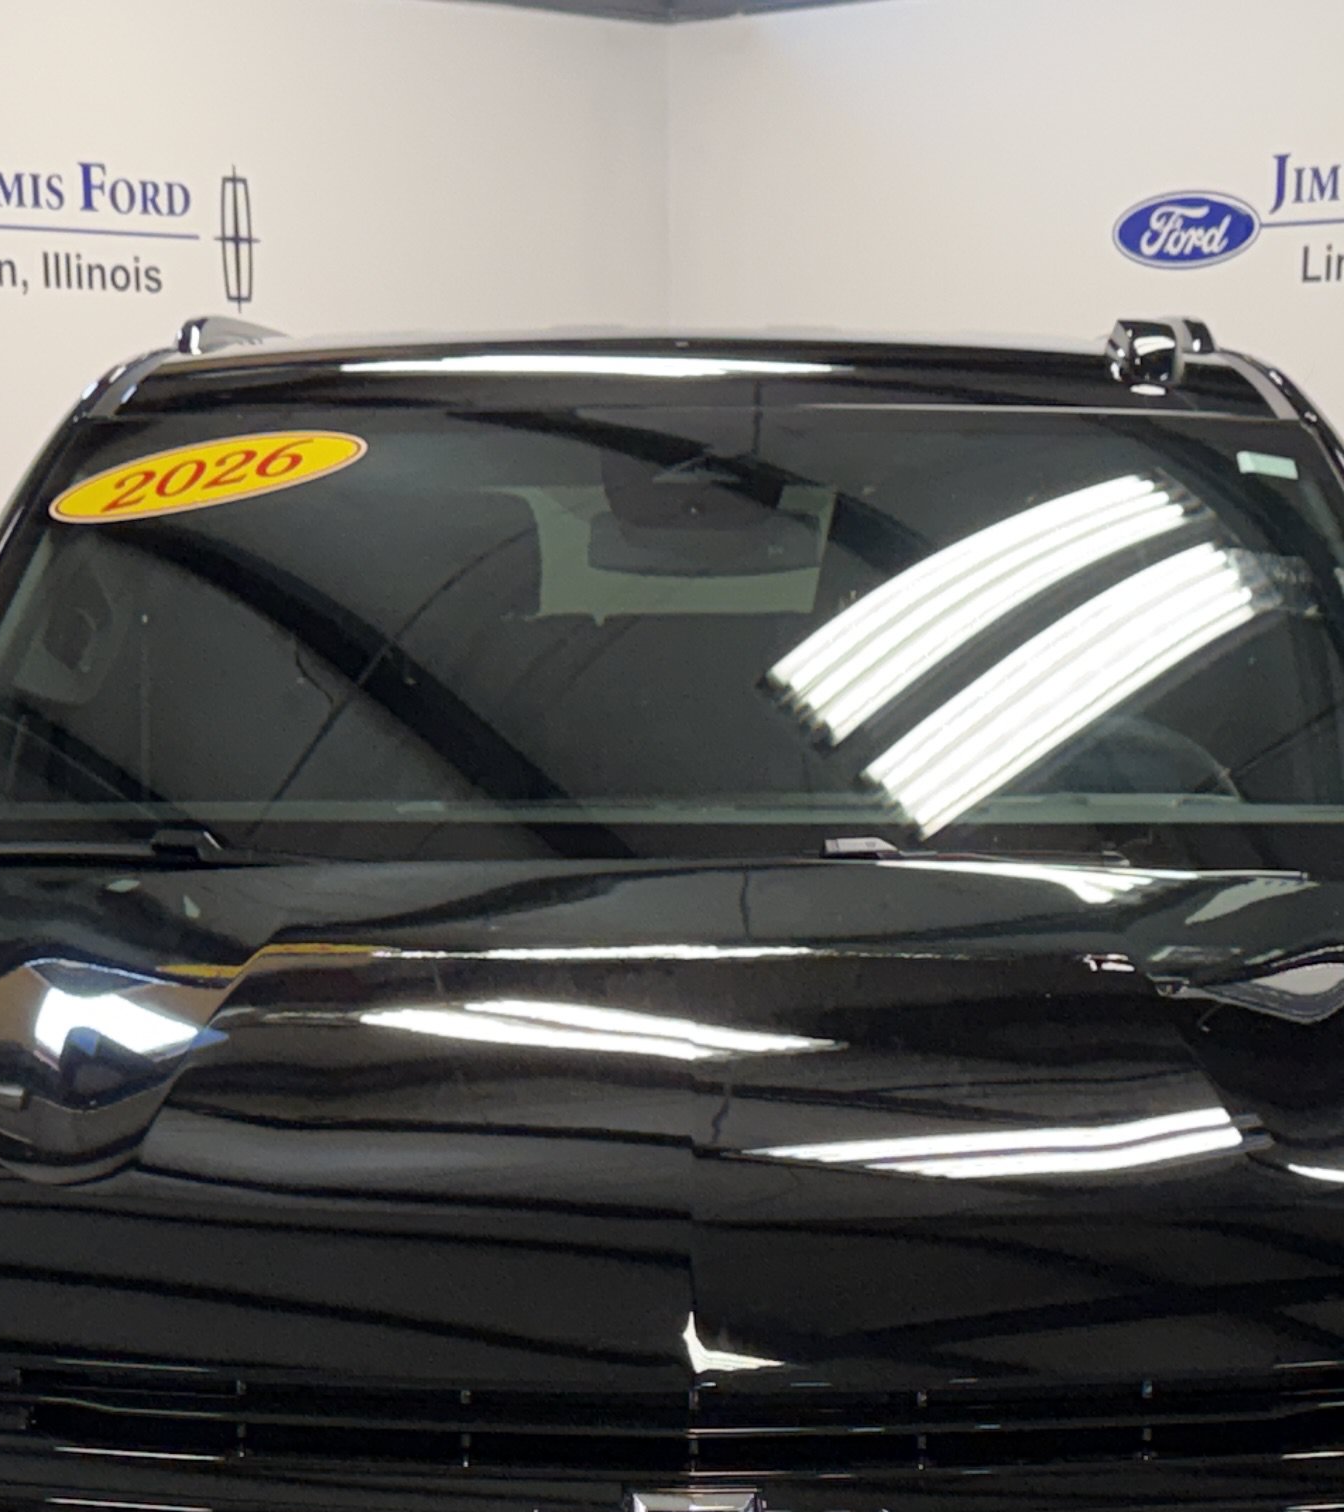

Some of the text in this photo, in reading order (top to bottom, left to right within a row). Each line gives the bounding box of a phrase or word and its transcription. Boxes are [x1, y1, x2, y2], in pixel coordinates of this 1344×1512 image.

[78, 162, 191, 217] FORD
[1270, 153, 1341, 214] JIM
[1140, 204, 1228, 256] Ford
[42, 251, 163, 293] Illinois
[100, 438, 314, 513] 2026
